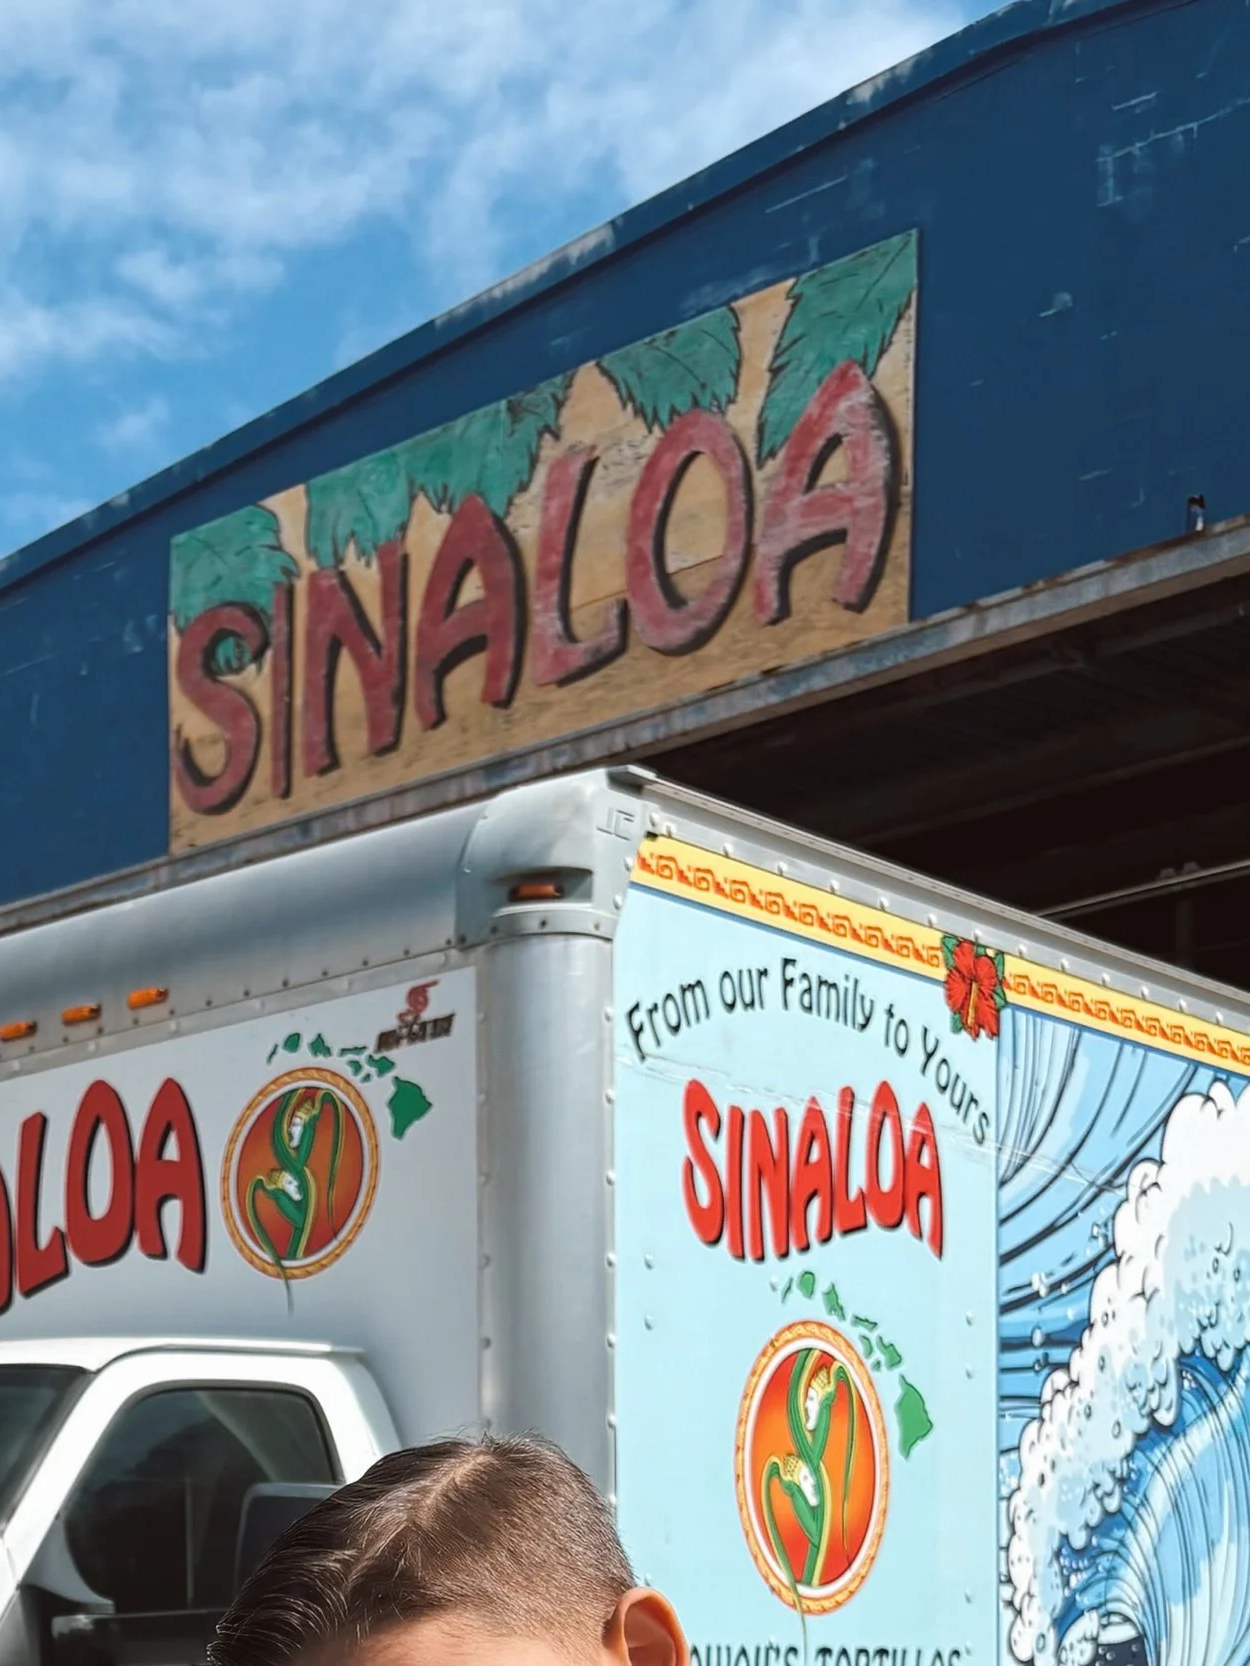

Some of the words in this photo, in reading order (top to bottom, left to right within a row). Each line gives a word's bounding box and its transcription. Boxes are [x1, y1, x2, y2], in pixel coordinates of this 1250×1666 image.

[173, 360, 902, 816] SINALOA
[626, 978, 711, 1063] From
[718, 966, 769, 1012] our
[781, 957, 874, 1034] Family
[883, 1002, 910, 1058] to
[921, 1025, 991, 1146] Yours
[681, 1079, 944, 1261] SINALOA
